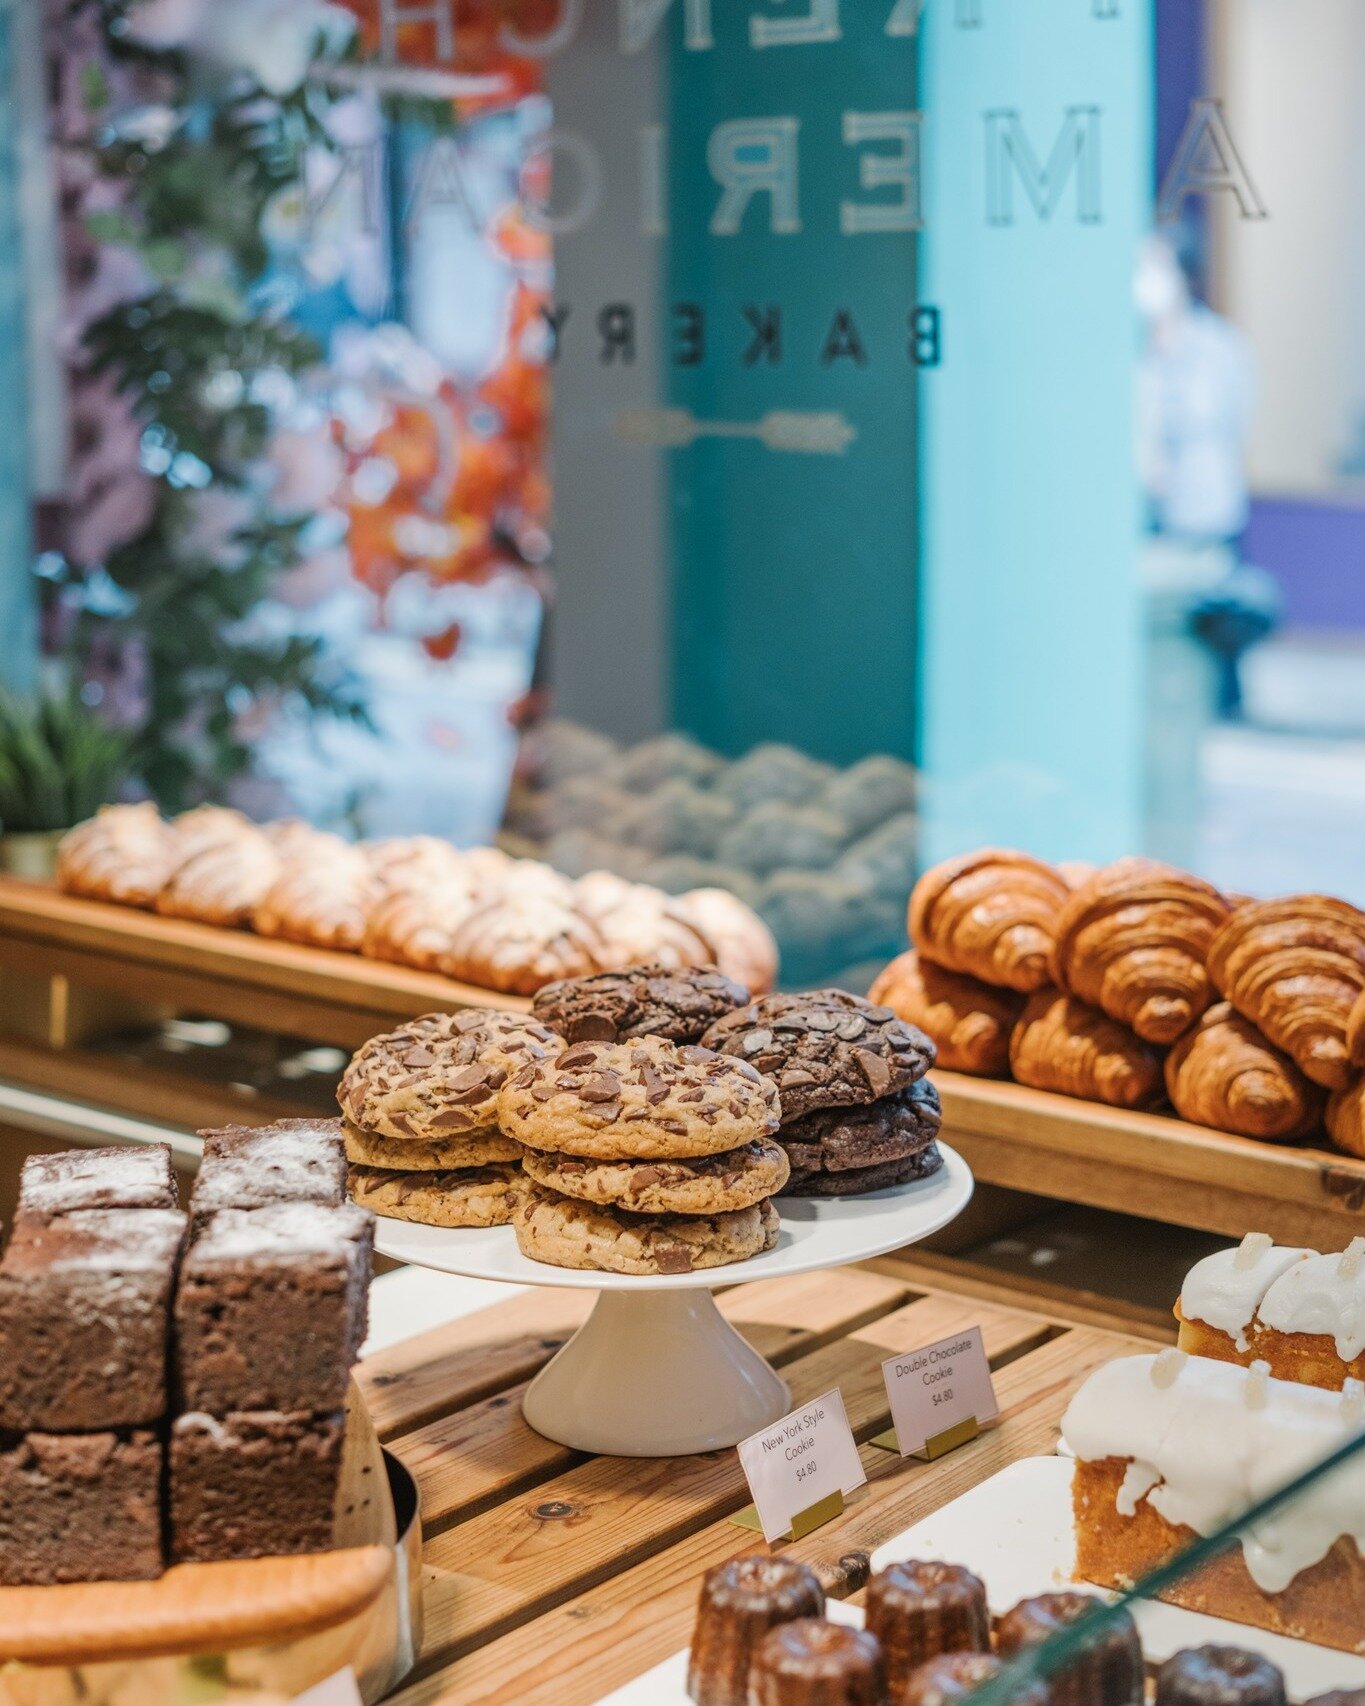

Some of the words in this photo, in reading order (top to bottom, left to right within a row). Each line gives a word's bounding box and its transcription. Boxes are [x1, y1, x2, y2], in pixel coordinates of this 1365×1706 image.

[895, 1355, 928, 1378] Double
[928, 1340, 973, 1364] Chocolate
[922, 1366, 953, 1386] Cookie
[932, 1388, 954, 1407] $4.80
[761, 1435, 784, 1453] New
[783, 1419, 803, 1440] York
[803, 1409, 825, 1429] Style
[784, 1437, 815, 1461] Cookie
[796, 1460, 817, 1482] $4.80
